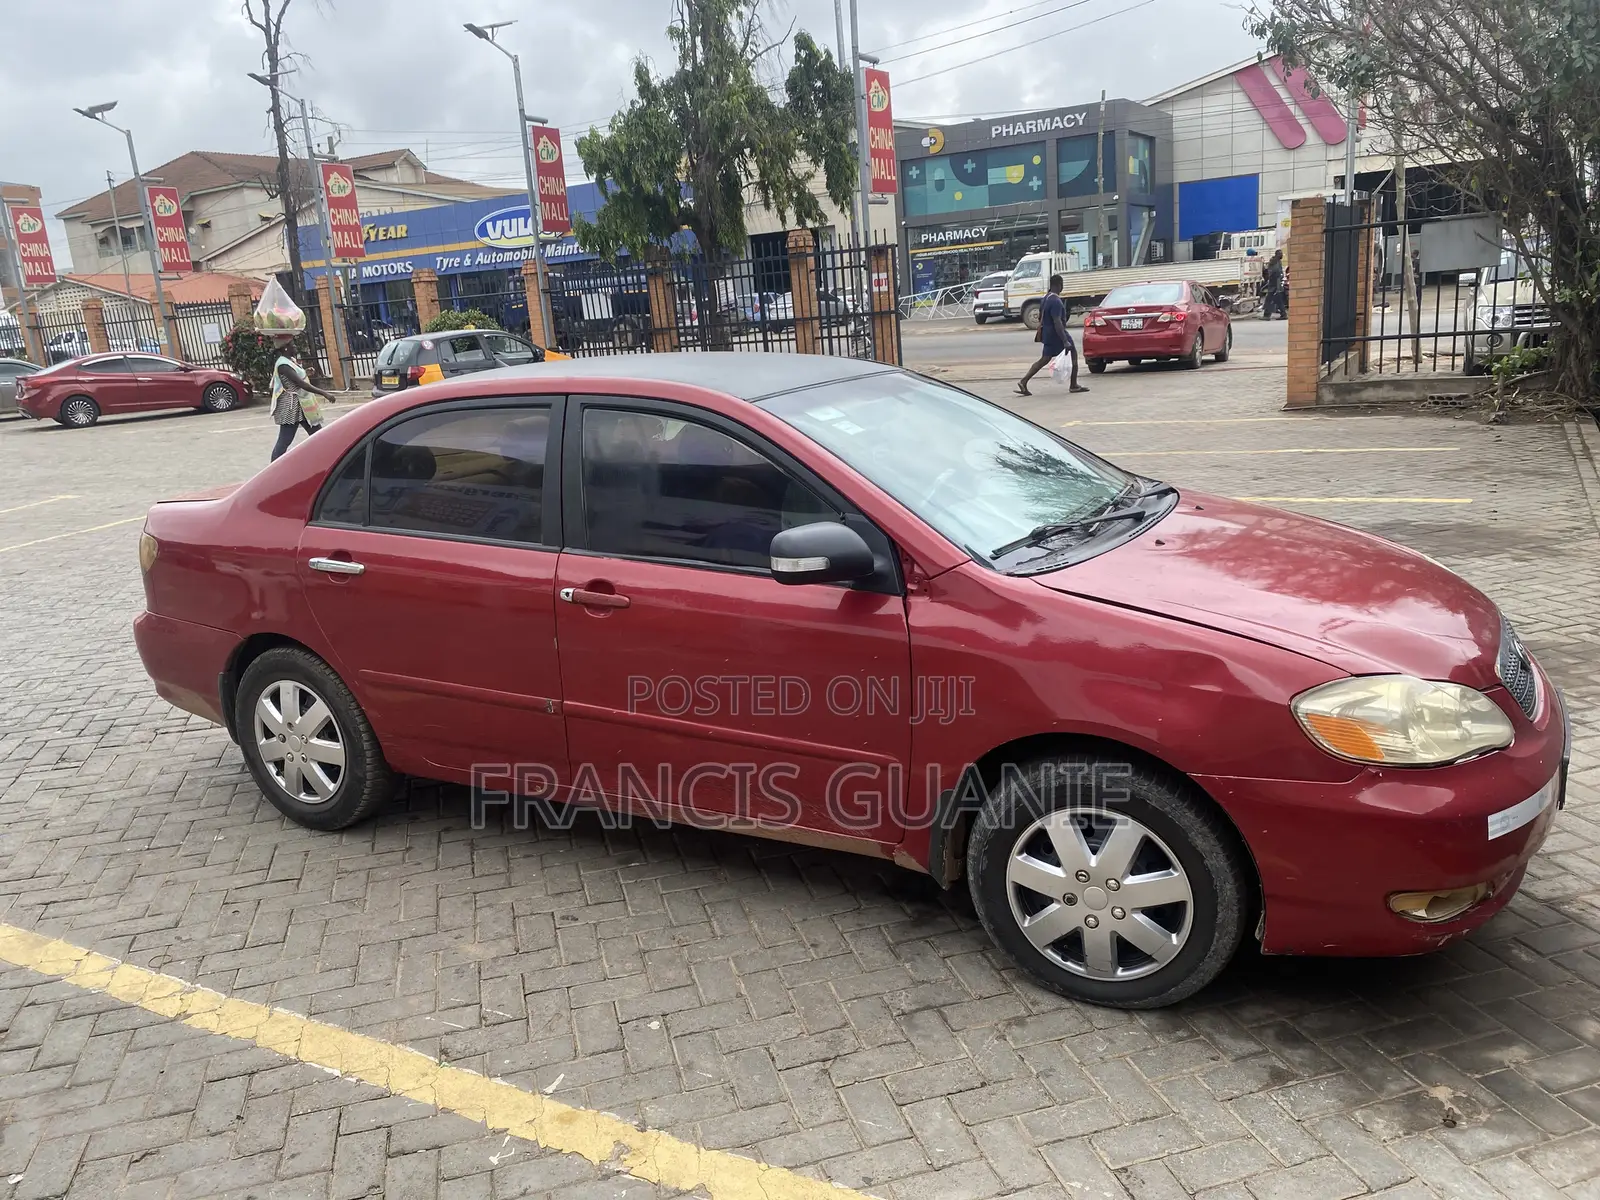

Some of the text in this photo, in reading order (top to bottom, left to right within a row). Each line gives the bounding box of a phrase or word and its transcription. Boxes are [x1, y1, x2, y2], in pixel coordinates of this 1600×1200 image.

[991, 112, 1087, 138] PHARMACY
[869, 126, 894, 150] CHINA
[871, 157, 896, 181] MALL
[539, 176, 566, 196] CHINA
[330, 208, 359, 225] CHINA
[541, 202, 569, 221] MALL
[156, 226, 186, 242] CHINA
[368, 224, 408, 242] YEAR
[486, 216, 552, 241] VUL
[921, 226, 988, 243] PHARMACY
[333, 231, 364, 248] MALL
[20, 243, 51, 257] CHINA
[160, 247, 190, 263] MALL
[436, 256, 460, 272] Tyre
[463, 255, 472, 266] &
[475, 246, 542, 265] Automobil
[23, 262, 55, 276] MALL
[362, 261, 414, 278] MOTORS
[874, 278, 888, 287] OUT
